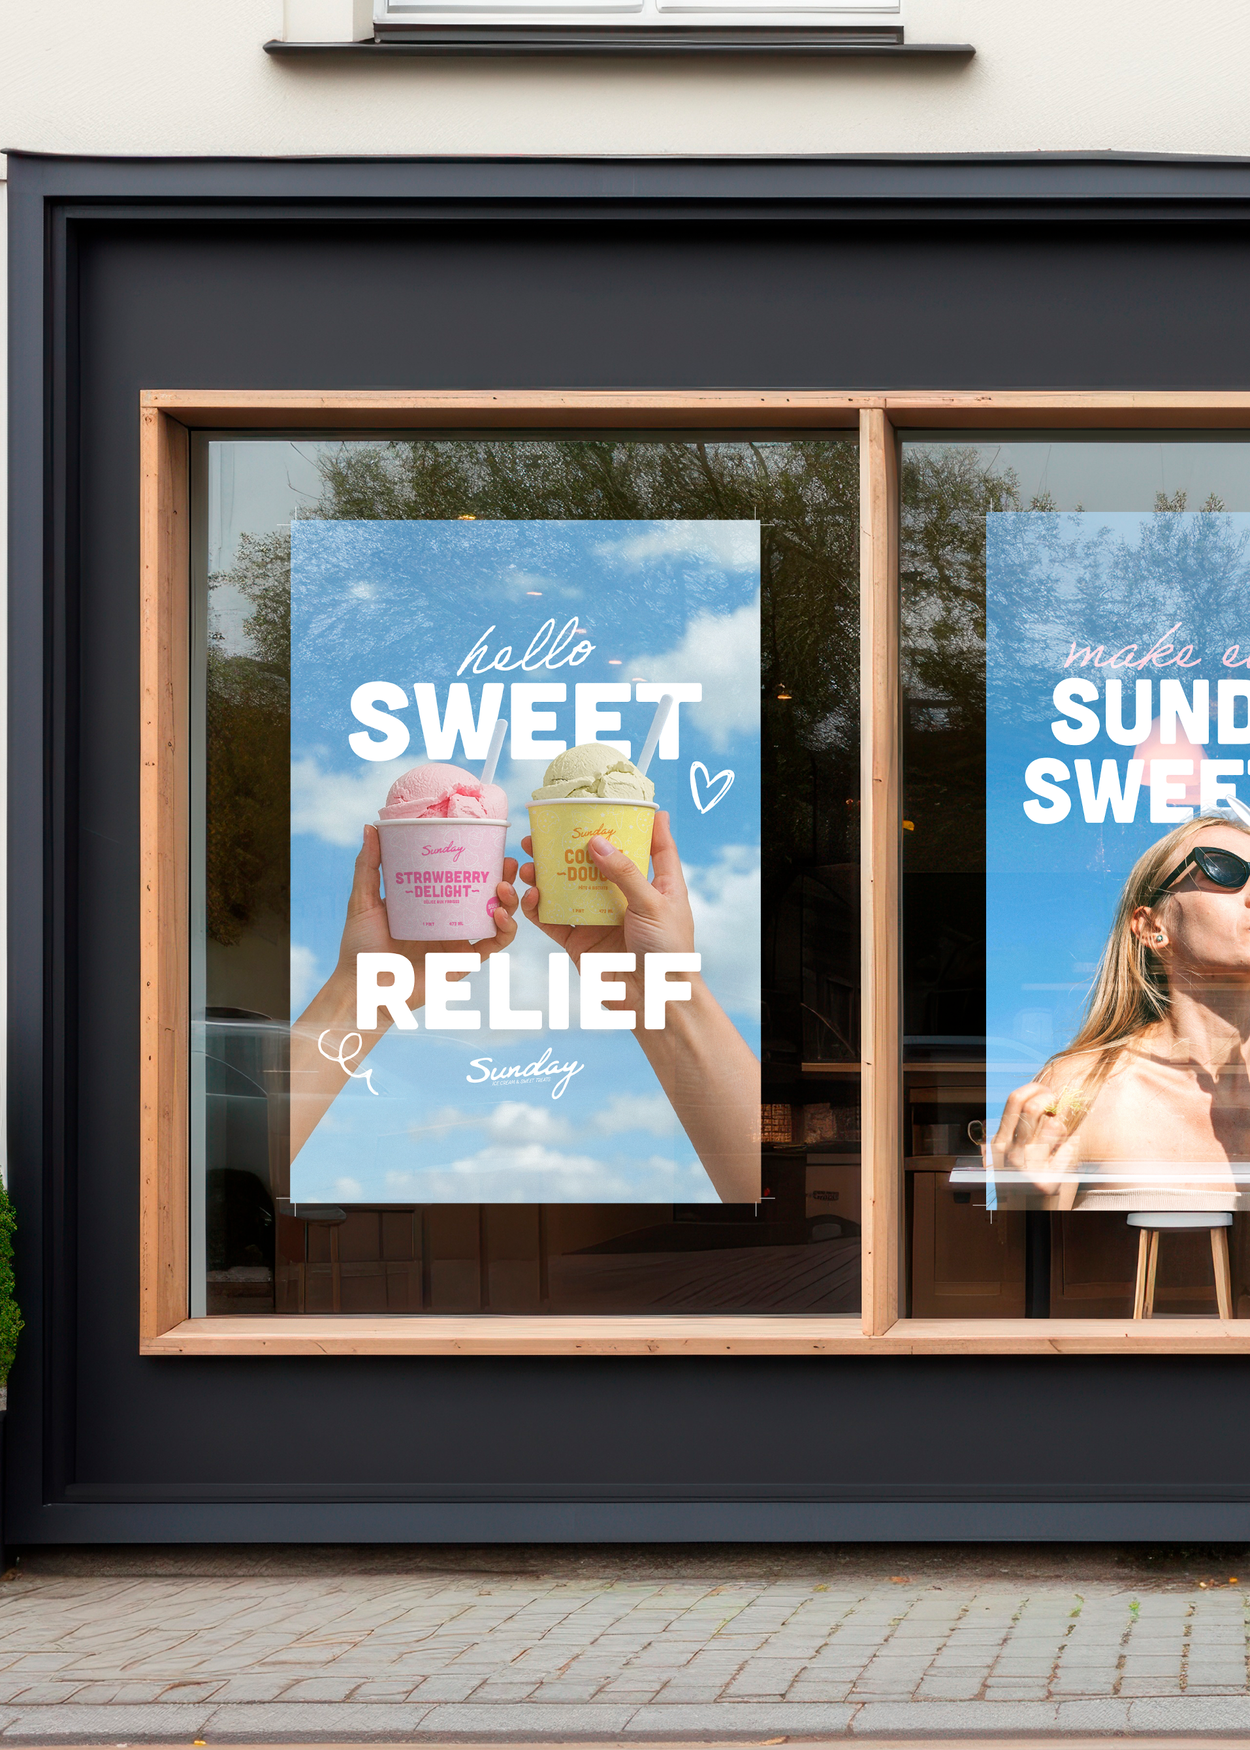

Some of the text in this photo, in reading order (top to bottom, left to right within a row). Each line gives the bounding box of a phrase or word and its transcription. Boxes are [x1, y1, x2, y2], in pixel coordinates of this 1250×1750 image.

[457, 616, 596, 676] hello
[1063, 622, 1202, 671] make
[348, 681, 703, 762] SWEET
[421, 841, 466, 862] Sunday
[395, 871, 490, 884] STRAWBERRY
[414, 884, 472, 898] DELIGHT
[356, 952, 702, 1030] RELIEF
[466, 1047, 585, 1100] Sunday
